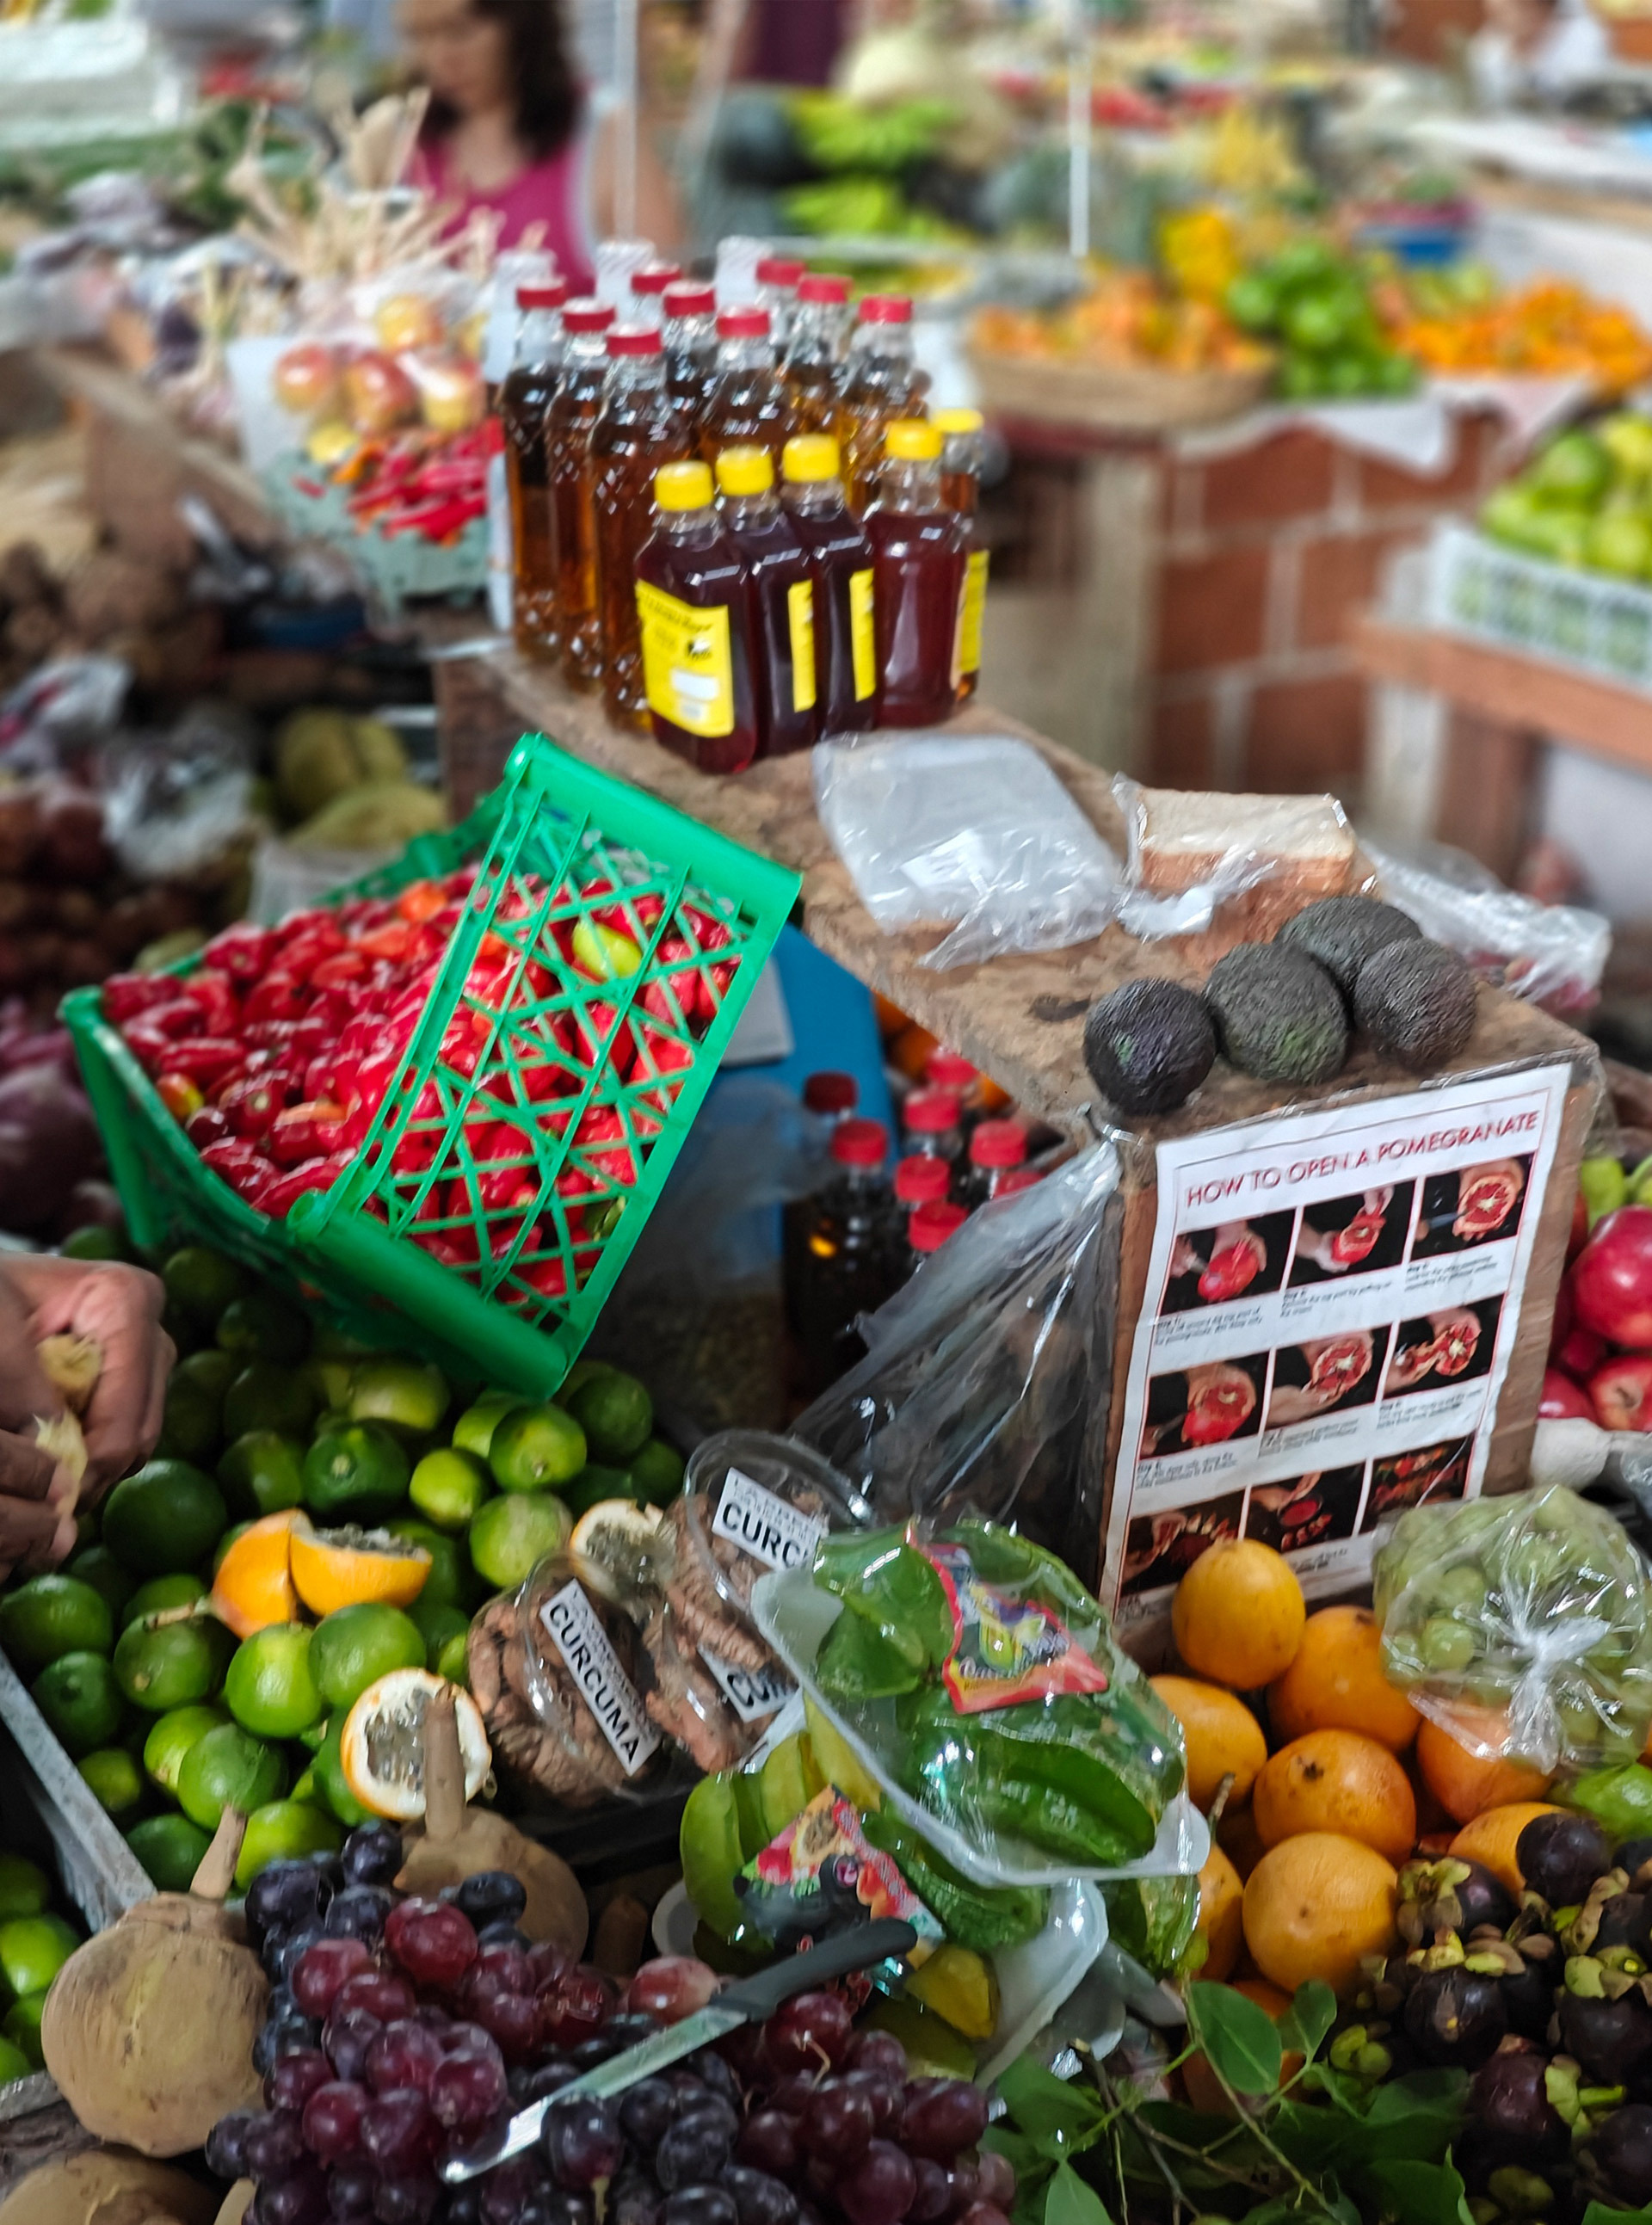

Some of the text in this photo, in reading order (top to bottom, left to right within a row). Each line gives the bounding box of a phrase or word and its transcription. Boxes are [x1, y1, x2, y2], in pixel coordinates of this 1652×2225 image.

[1187, 1110, 1539, 1207] HOW TO OPEN A POMEGRANATE
[723, 1501, 809, 1569] CURC
[549, 1604, 640, 1764] CURCUMA
